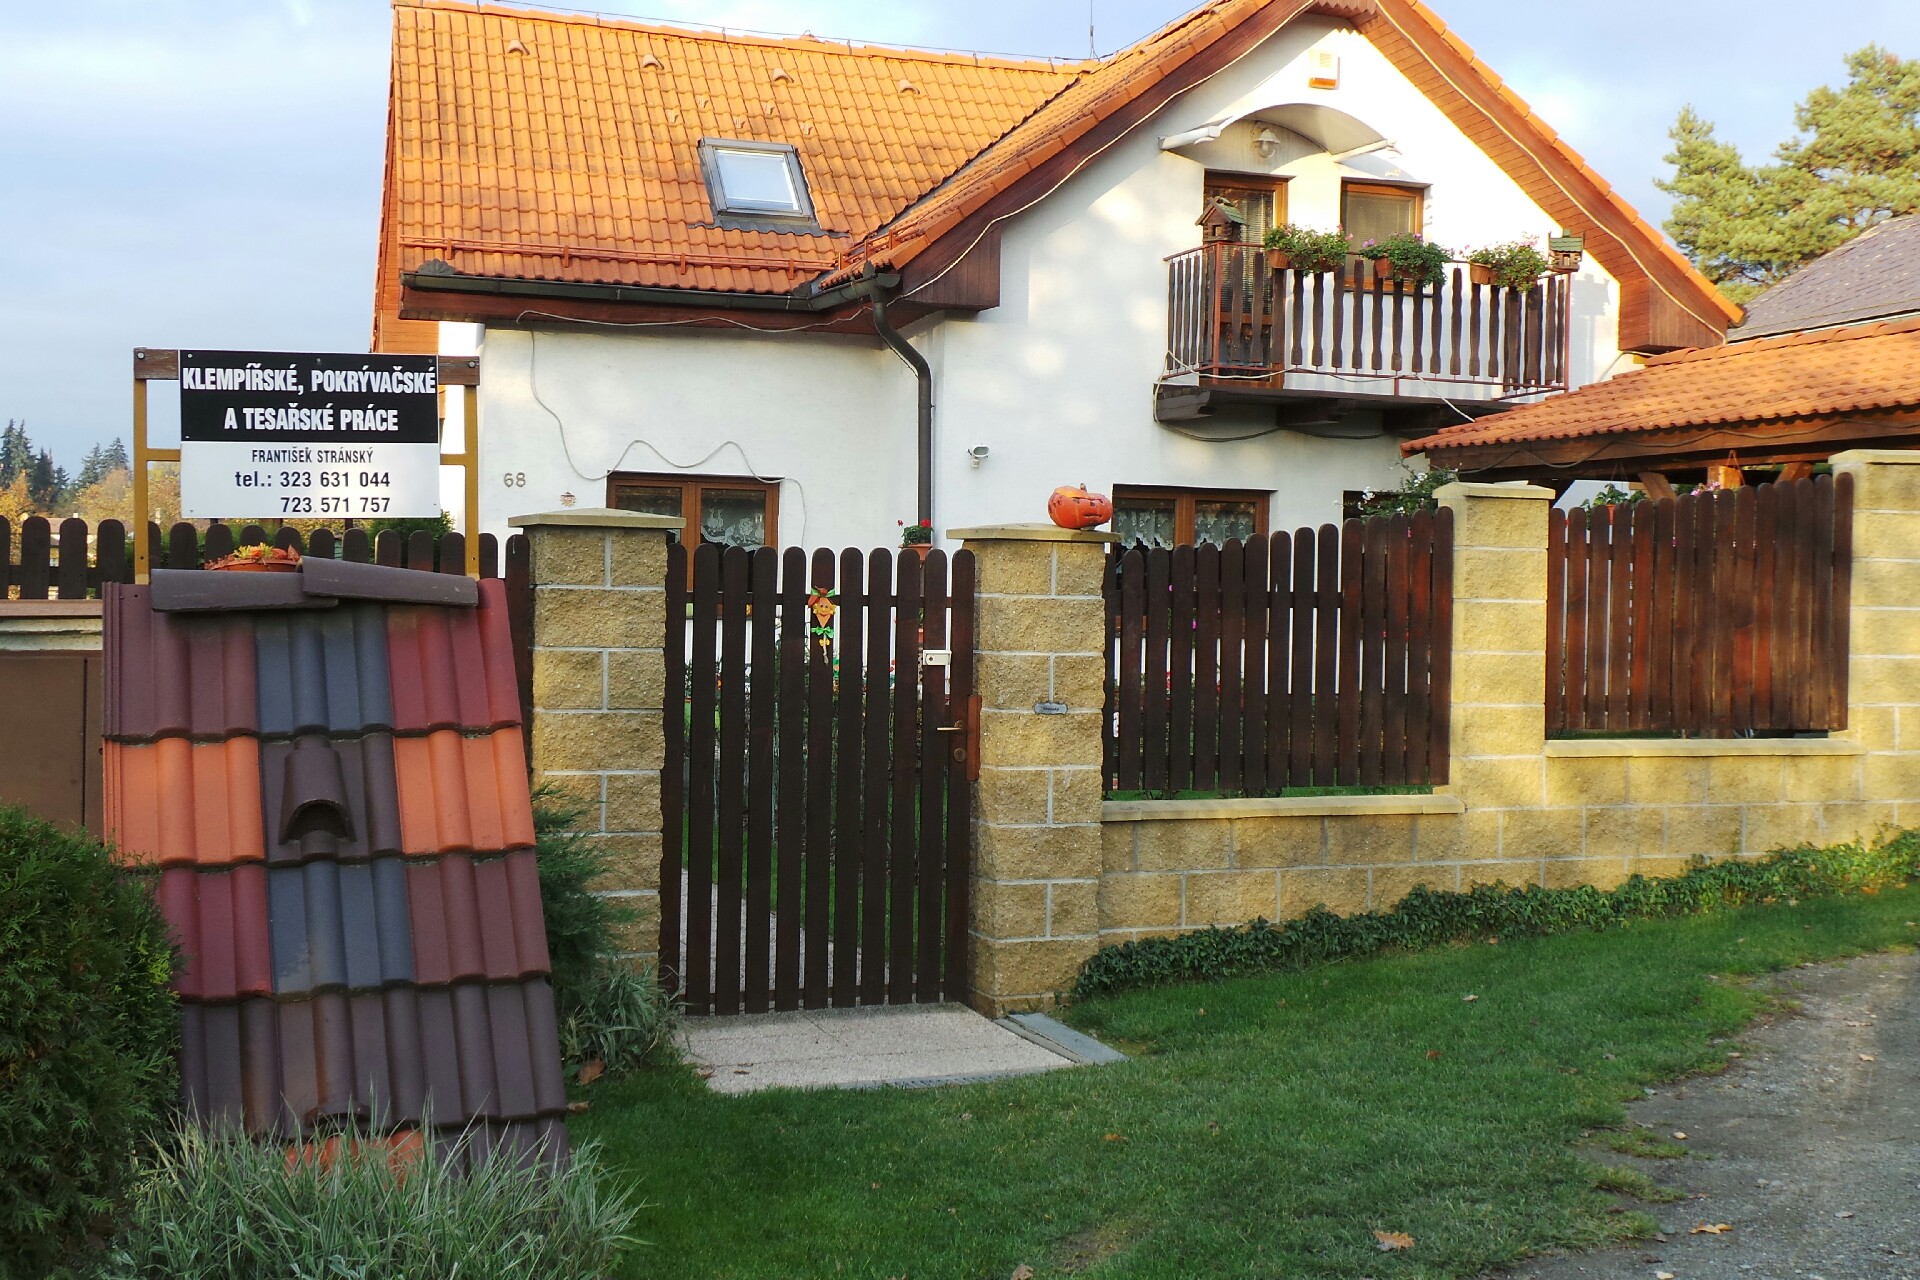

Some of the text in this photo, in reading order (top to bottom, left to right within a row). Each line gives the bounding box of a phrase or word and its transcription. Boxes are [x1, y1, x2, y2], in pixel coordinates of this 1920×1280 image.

[182, 362, 436, 395] KLEMPÍŘSKÉ, POKRÝVAČSKÉ
[224, 402, 399, 431] A TESAŘSKÉ PRÁCE
[251, 446, 374, 464] FRANTIŠEK STRÁNSKÝ
[235, 471, 390, 488] tel.: 323 631 044
[503, 472, 526, 488] 68
[320, 497, 349, 513] 571
[361, 497, 391, 513] 757
